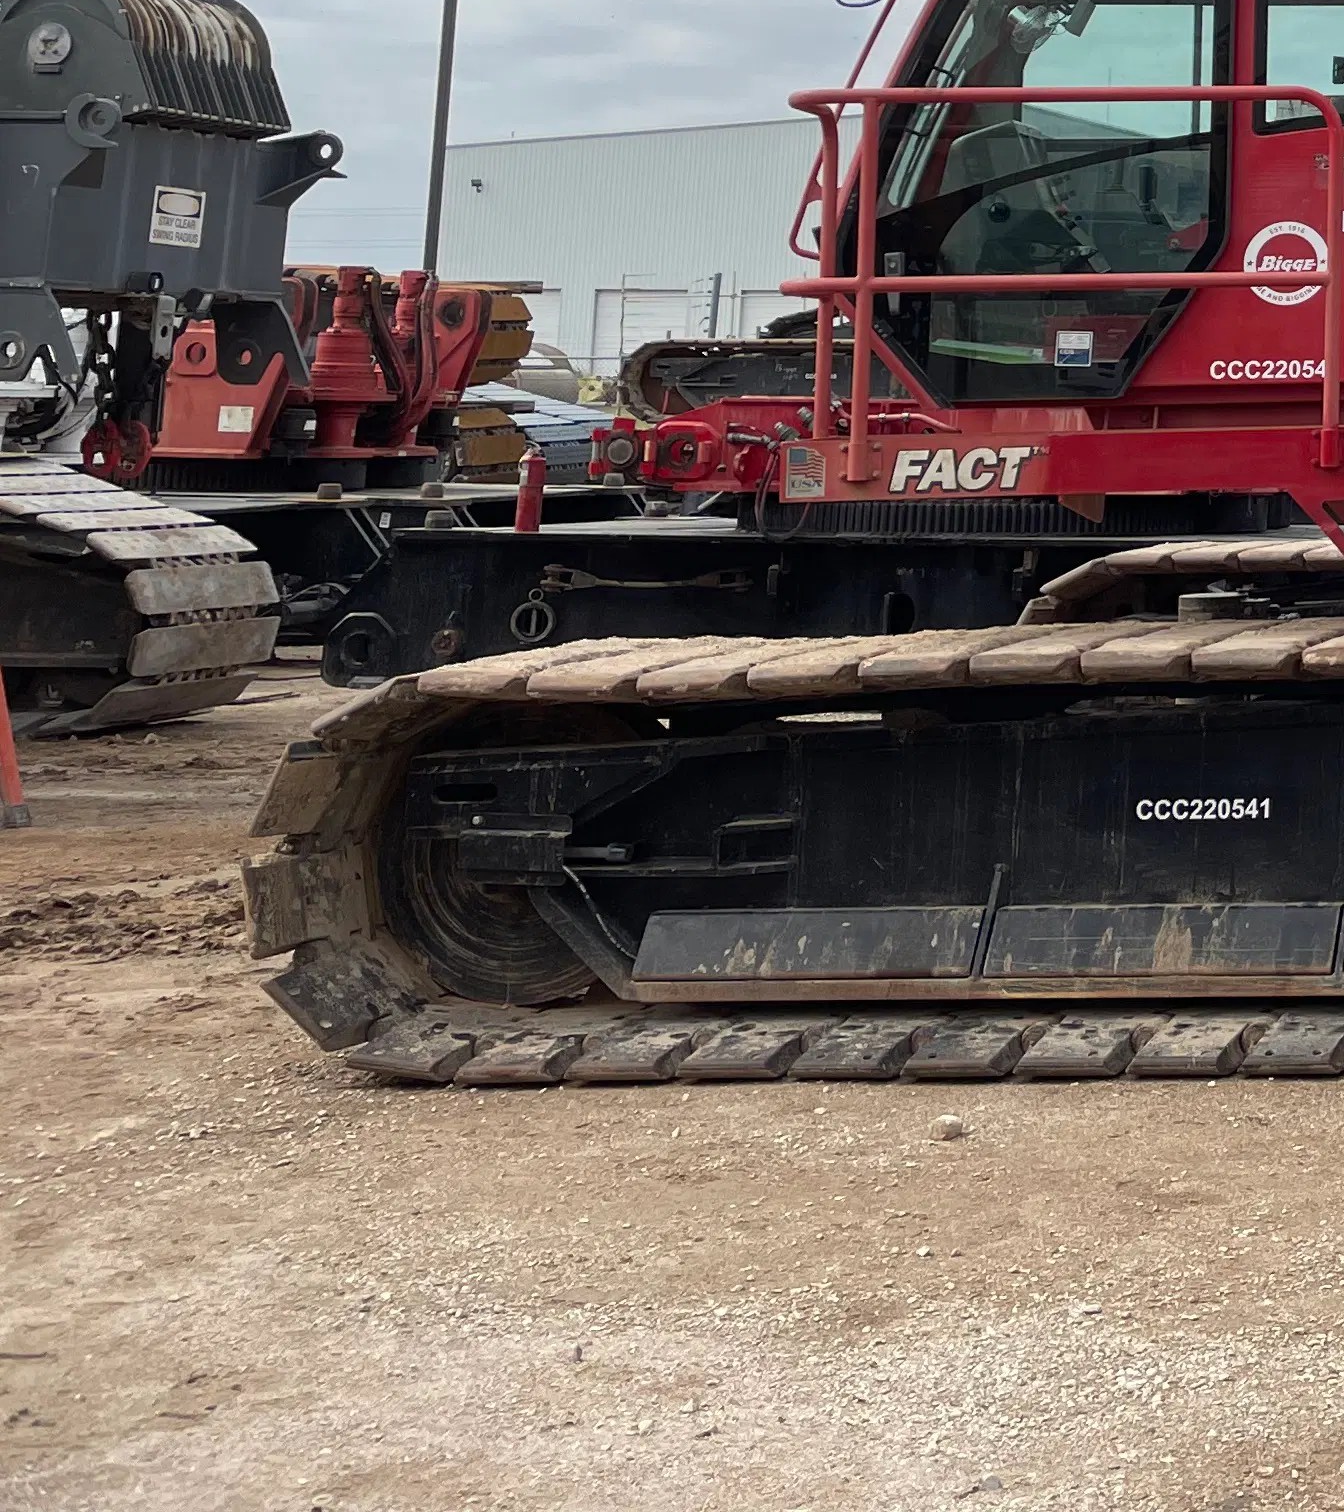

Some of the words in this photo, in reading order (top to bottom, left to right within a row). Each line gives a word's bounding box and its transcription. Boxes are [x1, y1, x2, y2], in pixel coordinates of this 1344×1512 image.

[174, 217, 196, 231] CLEAR
[889, 446, 1032, 494] FACT
[1135, 797, 1271, 820] CCC220541
